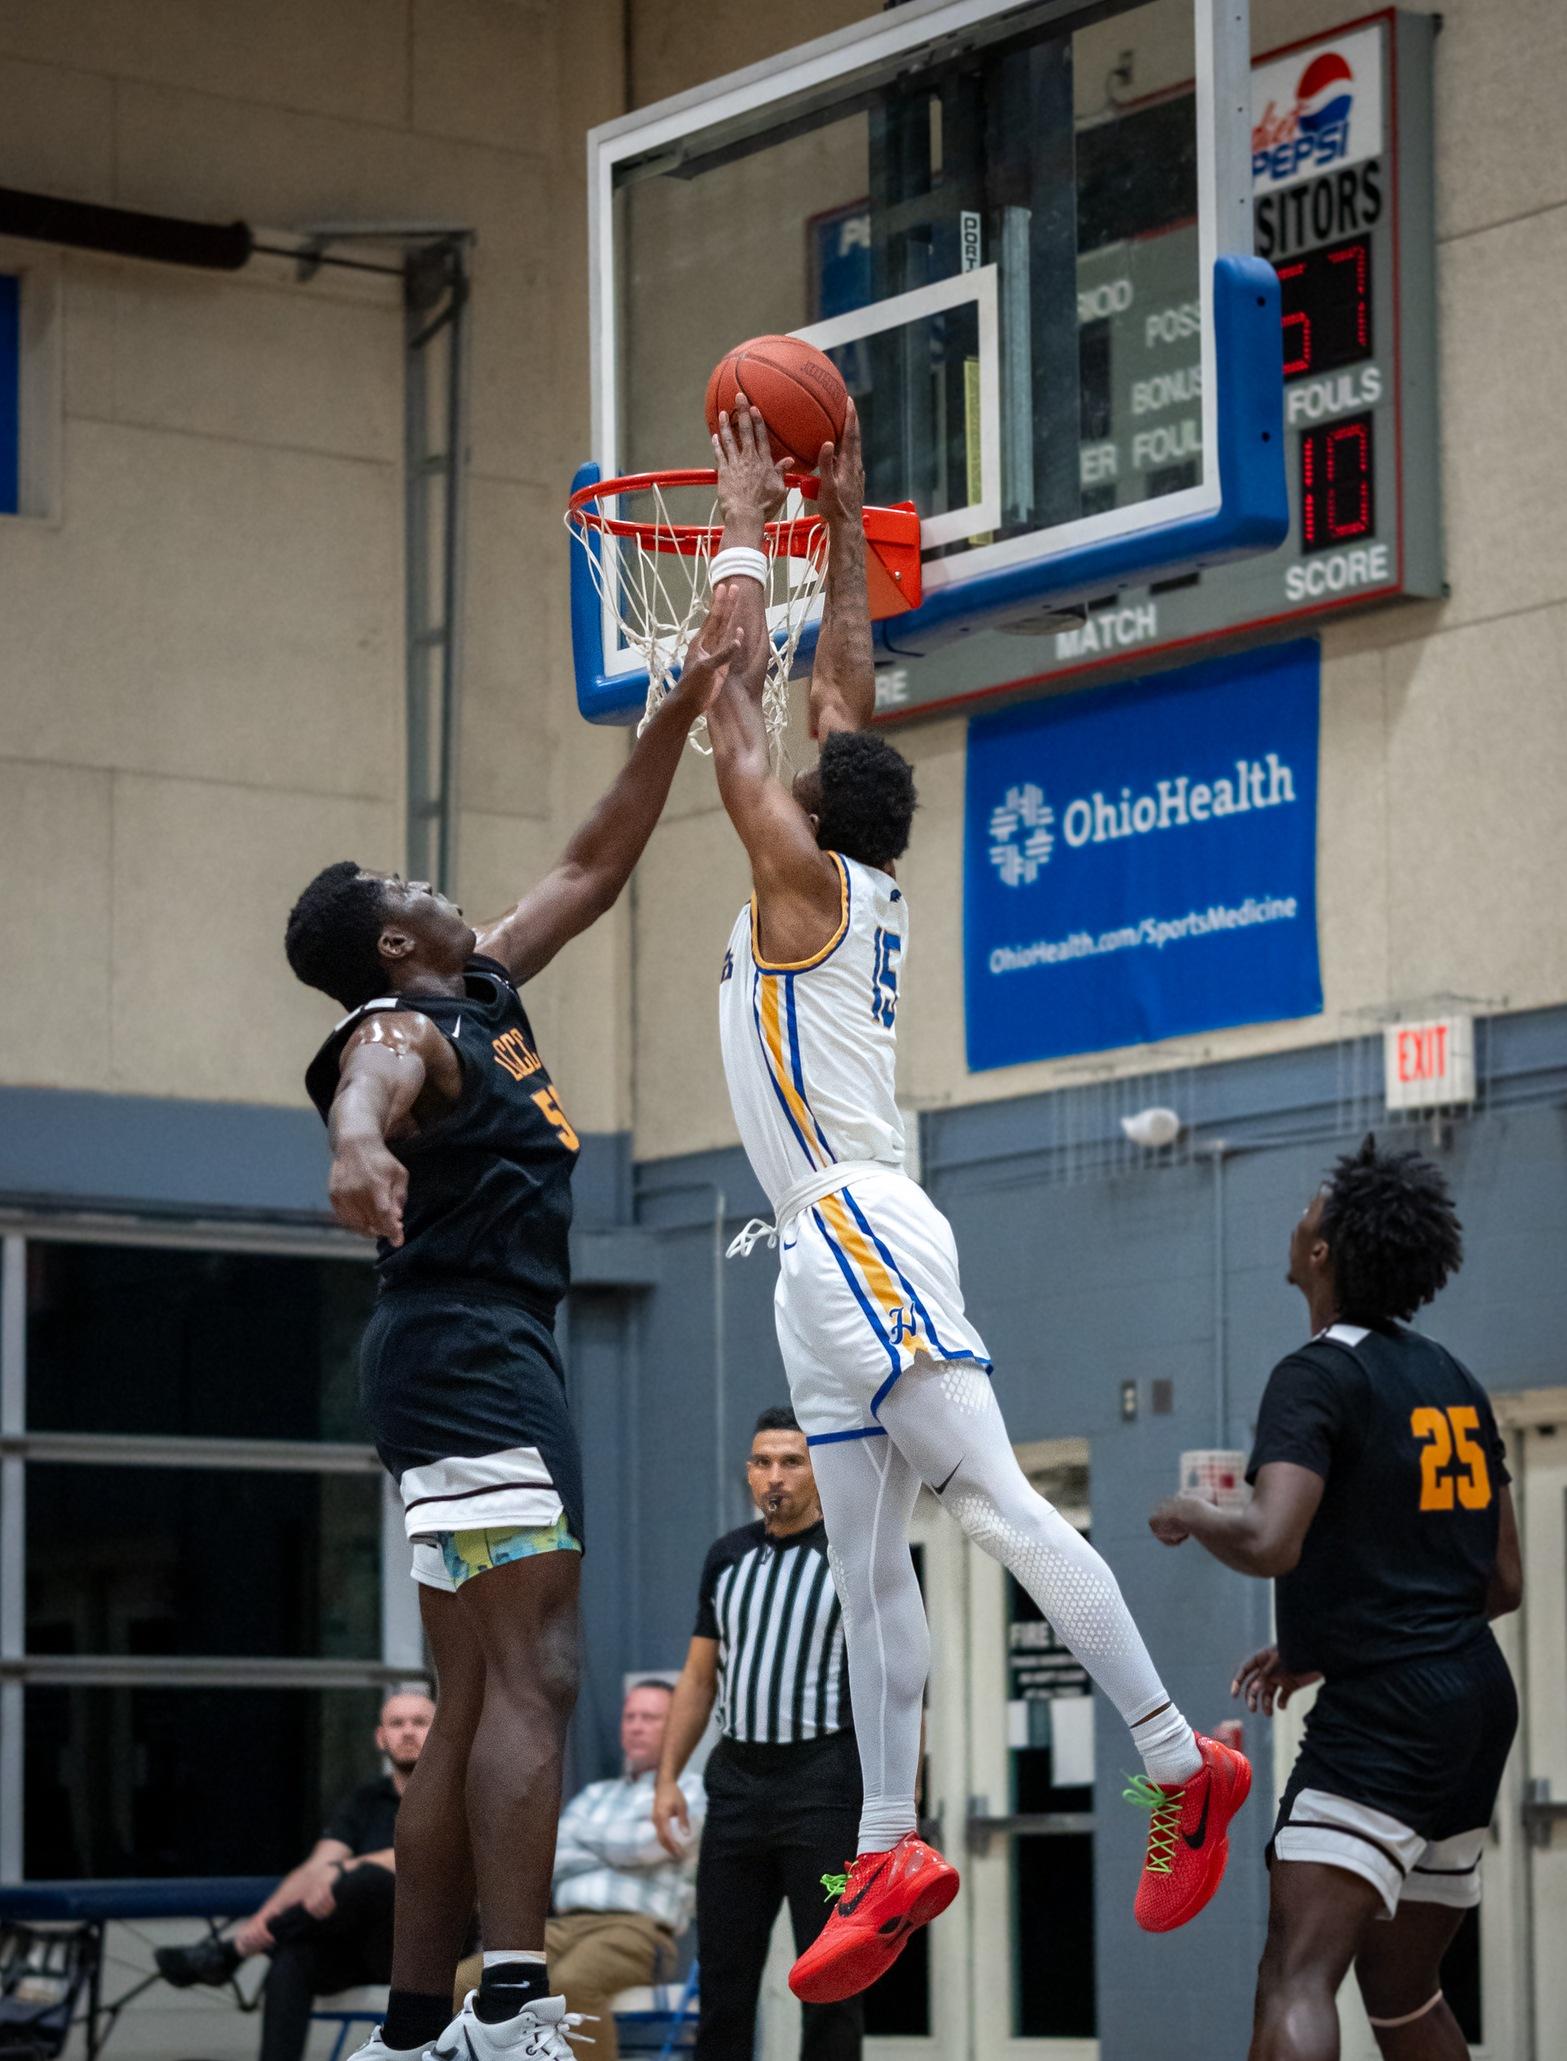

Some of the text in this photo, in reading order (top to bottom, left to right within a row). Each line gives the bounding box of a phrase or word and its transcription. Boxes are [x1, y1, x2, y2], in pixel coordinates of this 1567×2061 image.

[1252, 120, 1350, 183] PEPSI
[1255, 159, 1382, 259] SITORS
[963, 216, 979, 272] PORT
[1286, 366, 1383, 424] FOULS
[1303, 422, 1368, 543] 10
[1285, 544, 1390, 602] SCORE
[1055, 603, 1157, 661] MATCH
[1063, 753, 1297, 848] OhioHealth
[989, 896, 1298, 975] OhioHealth.com/SportsMedicine
[1397, 1025, 1448, 1083] EXIT
[1410, 1406, 1492, 1511] 25
